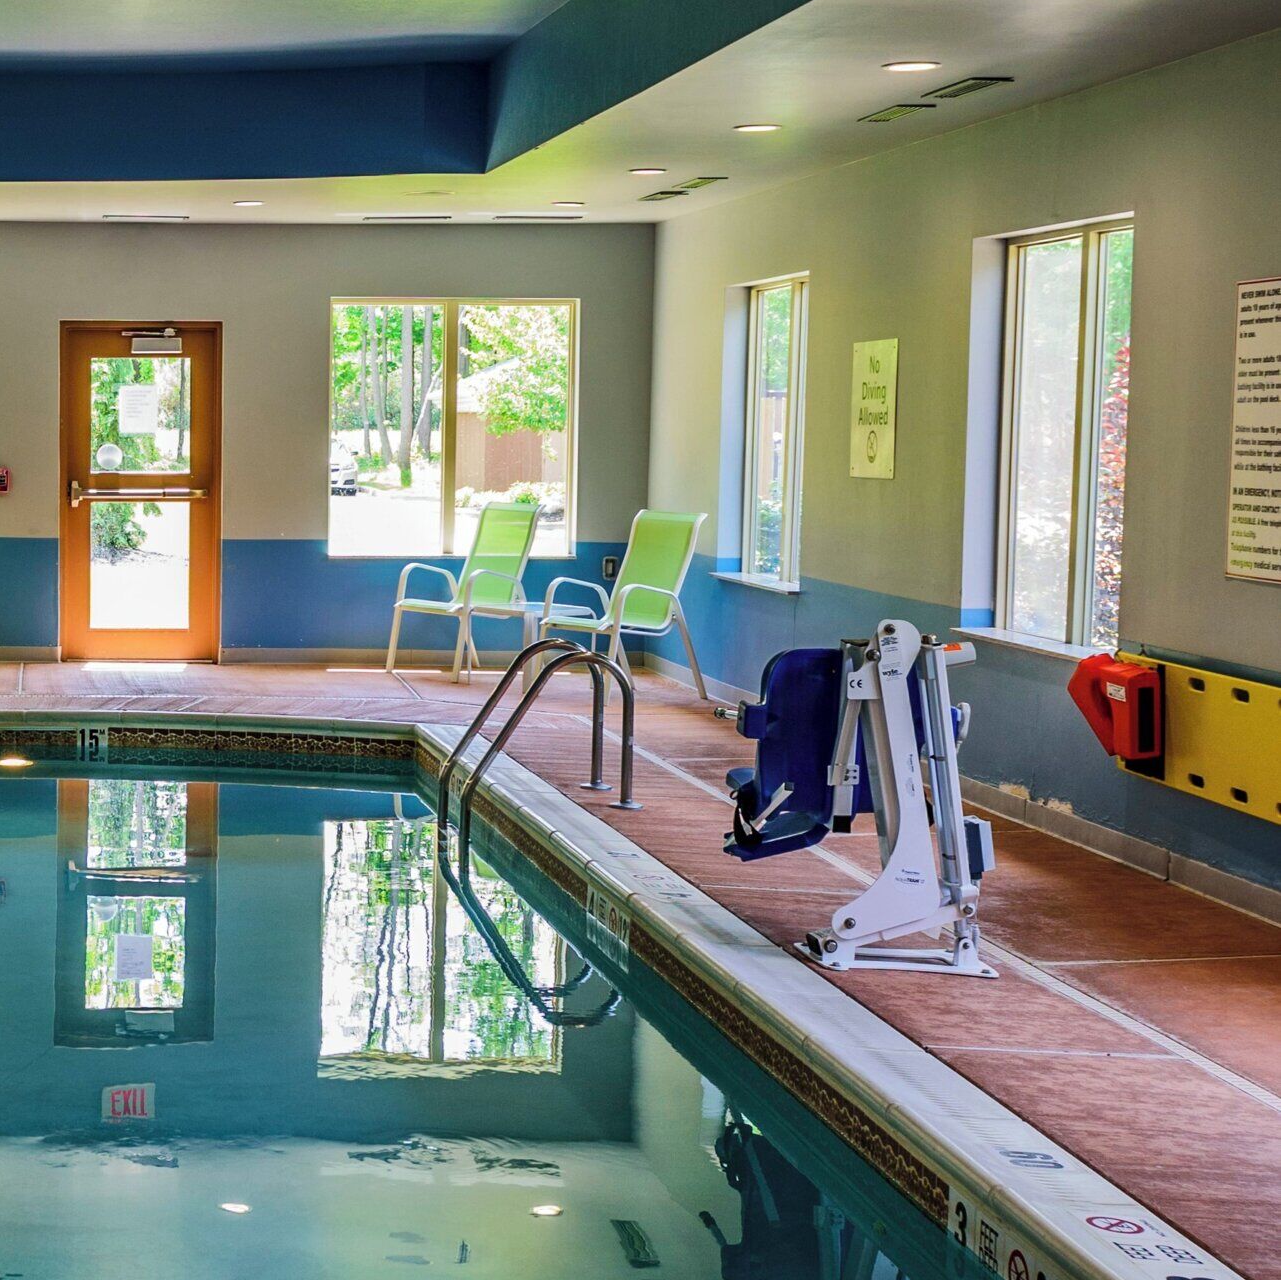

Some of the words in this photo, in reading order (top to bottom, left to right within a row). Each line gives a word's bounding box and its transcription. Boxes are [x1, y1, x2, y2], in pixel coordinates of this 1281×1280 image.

[1241, 291, 1254, 299] NEVER
[870, 356, 880, 374] No
[862, 381, 886, 404] Diving
[858, 406, 889, 426] Allowed
[850, 680, 862, 688] CE
[954, 1201, 968, 1248] 3
[1112, 1241, 1161, 1262] FEET
[1156, 1244, 1204, 1265] DEEP
